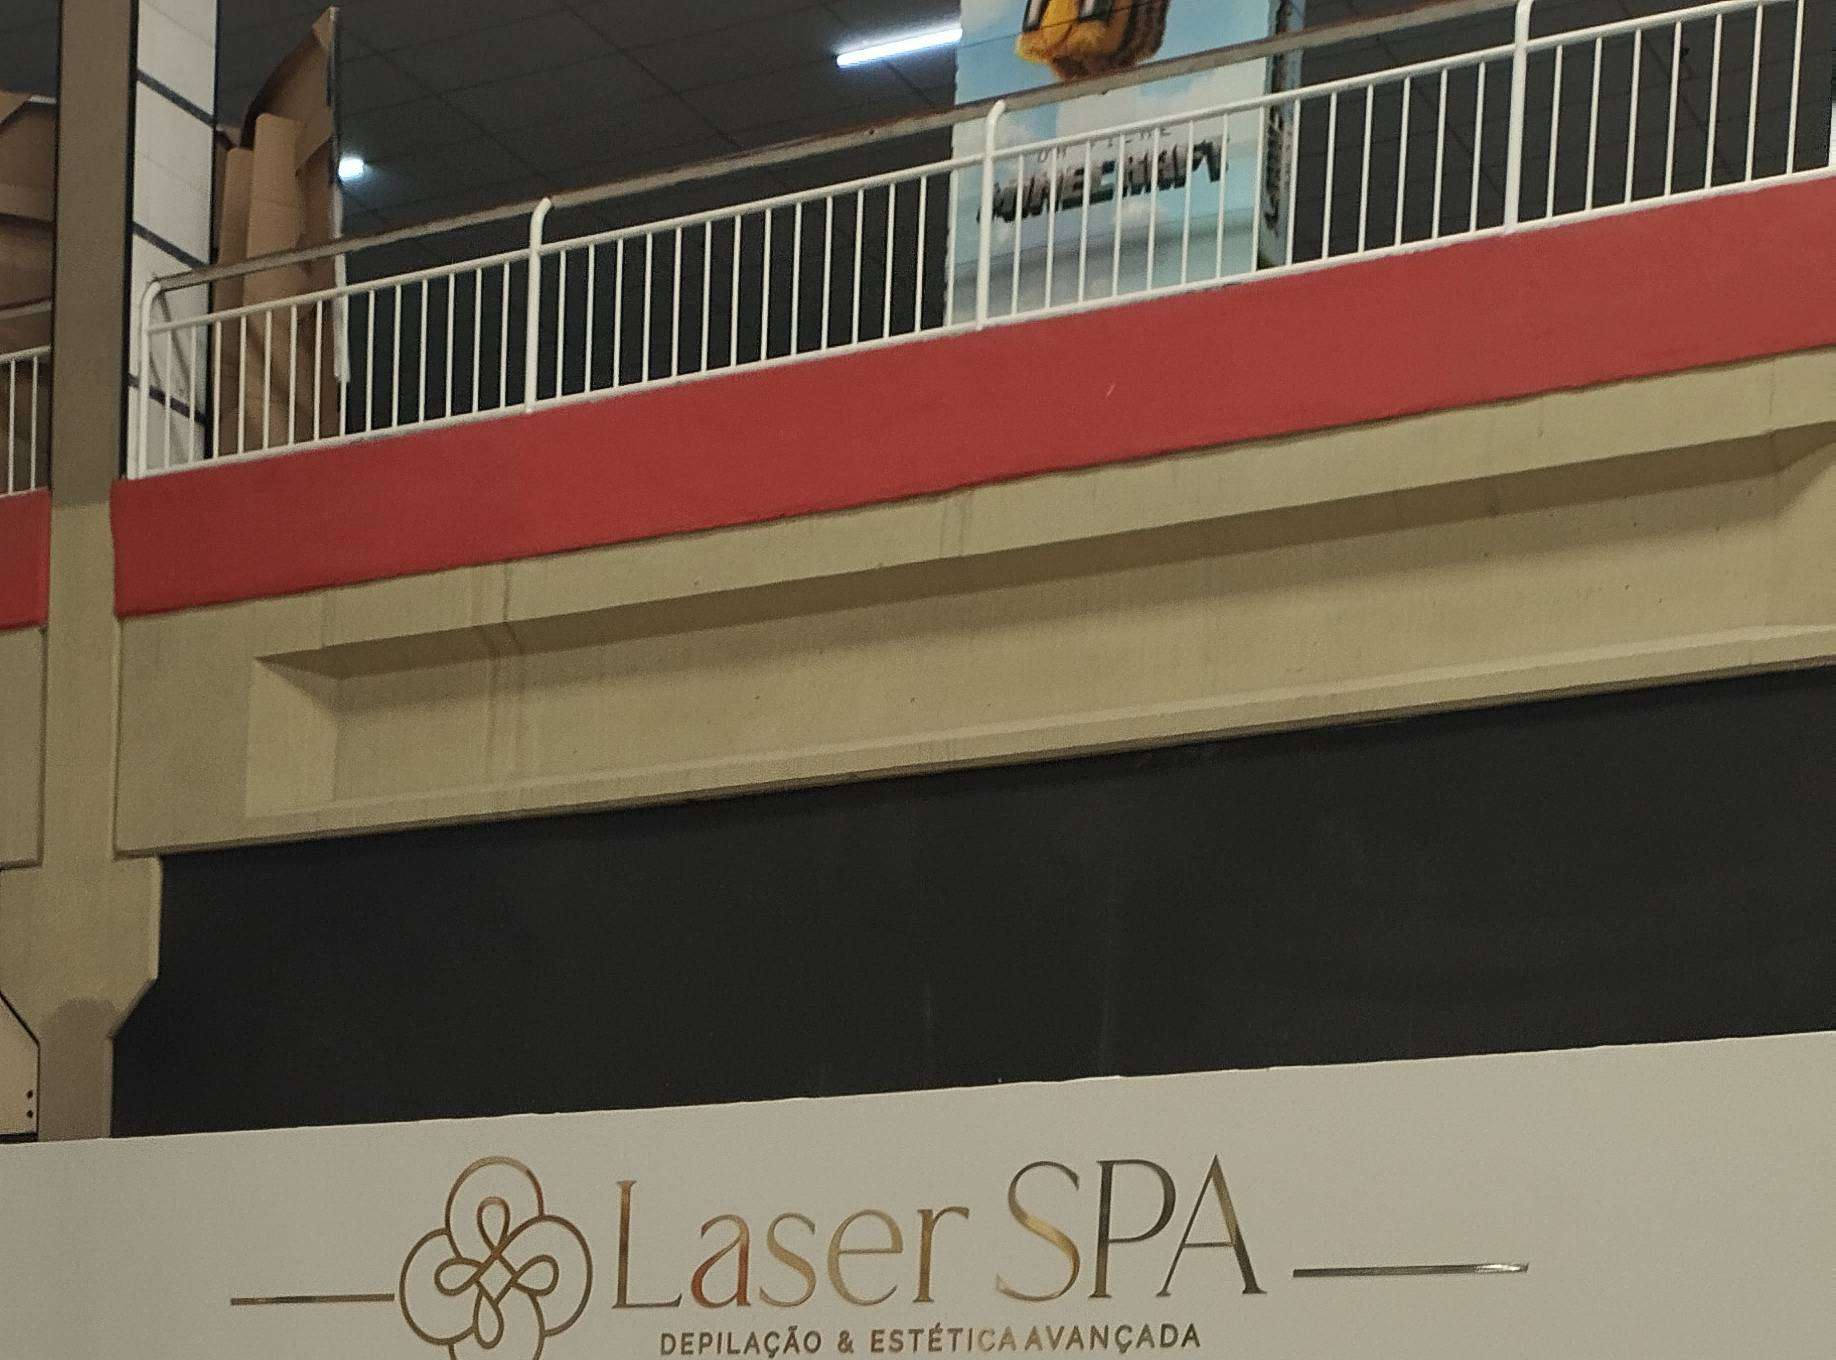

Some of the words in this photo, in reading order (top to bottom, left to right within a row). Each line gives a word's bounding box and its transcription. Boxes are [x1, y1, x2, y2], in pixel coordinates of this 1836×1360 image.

[611, 1180, 970, 1310] Laser
[996, 1154, 1268, 1303] SPA
[660, 1325, 822, 1359] DEPILAÇÃO
[837, 1329, 854, 1354] &
[870, 1322, 1017, 1353] ESTÉTICA
[1024, 1323, 1200, 1354] AVANÇADA
